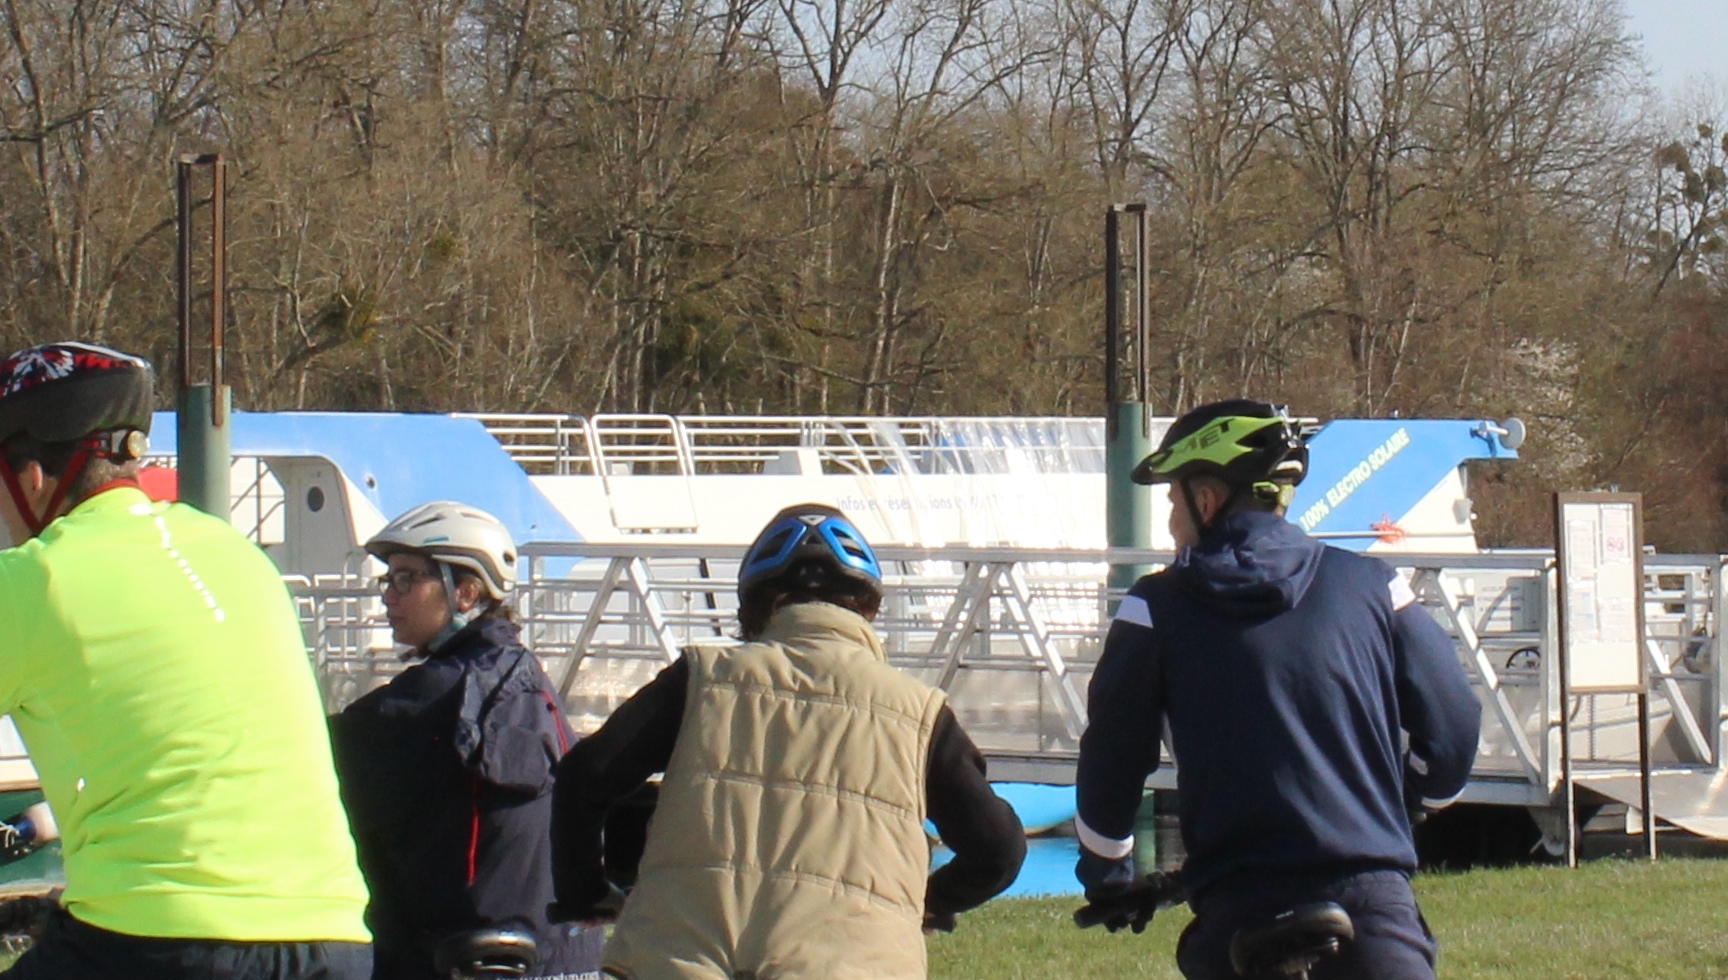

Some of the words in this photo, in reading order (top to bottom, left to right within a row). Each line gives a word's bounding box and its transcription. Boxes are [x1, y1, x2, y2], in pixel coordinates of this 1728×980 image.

[1175, 417, 1234, 454] MET
[1298, 498, 1331, 532] 100%
[1326, 460, 1372, 508] ELECTRO
[1368, 426, 1411, 471] SOLAIRE
[836, 495, 866, 511] Infos
